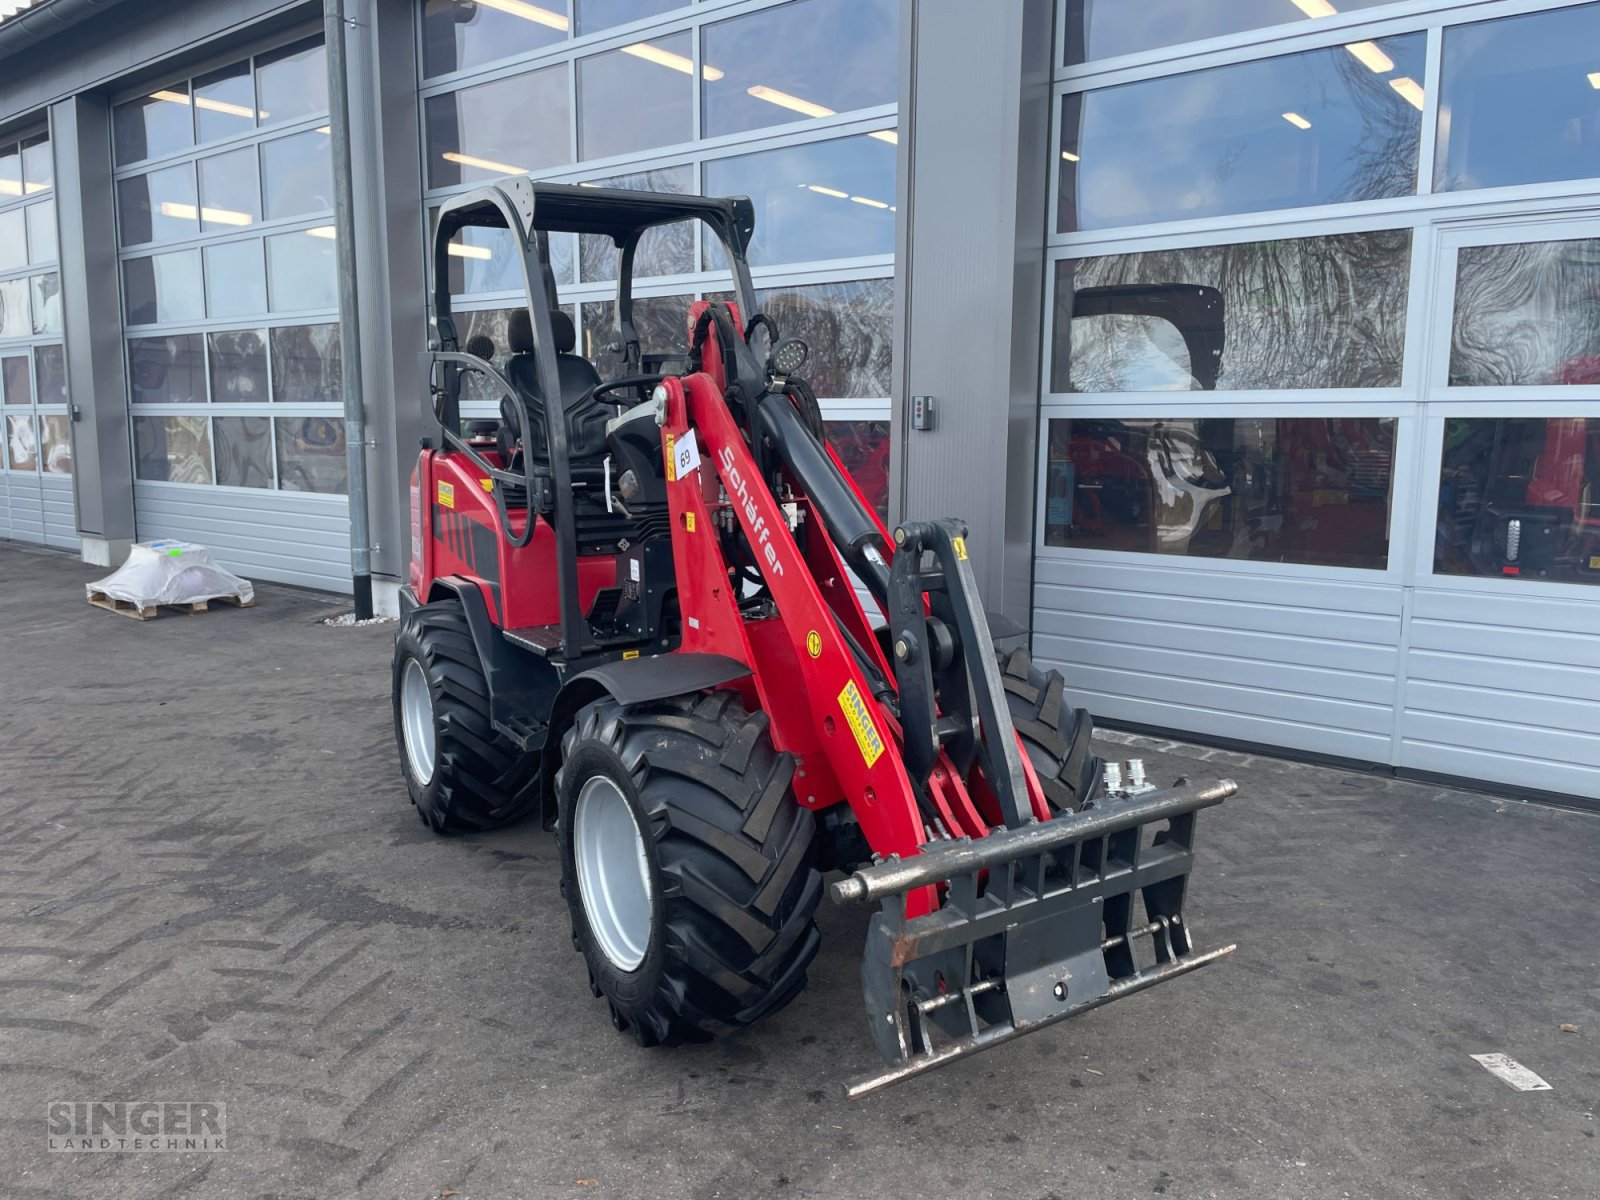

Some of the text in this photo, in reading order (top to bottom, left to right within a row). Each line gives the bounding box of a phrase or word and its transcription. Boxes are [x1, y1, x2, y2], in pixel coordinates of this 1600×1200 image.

[680, 449, 690, 468] 69
[718, 446, 783, 577] Schäffer
[847, 683, 881, 755] SINGER
